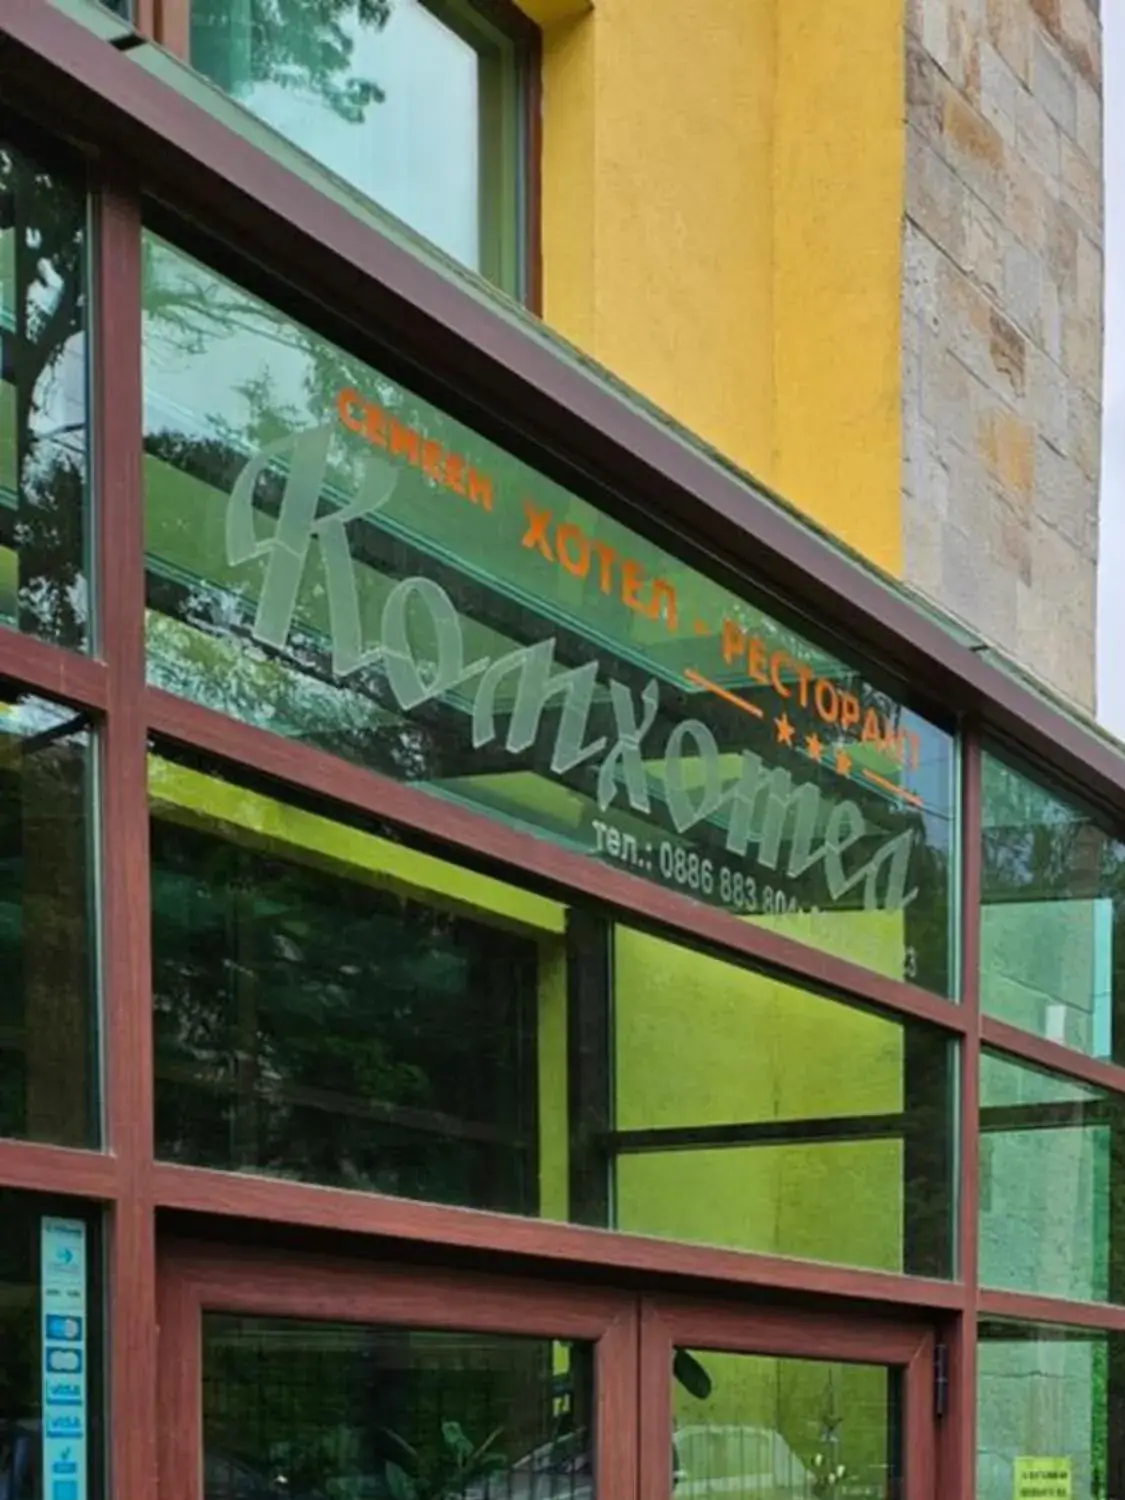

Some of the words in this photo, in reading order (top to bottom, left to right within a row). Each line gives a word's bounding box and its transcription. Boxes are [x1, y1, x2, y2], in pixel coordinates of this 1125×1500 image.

[336, 386, 493, 513] СЕМЕЕН
[521, 495, 679, 633] ХОТЕЛ
[722, 616, 919, 771] РЕСТОРАНТ
[591, 819, 653, 872] тел.:
[659, 841, 714, 896] 0886
[719, 866, 757, 912] 883
